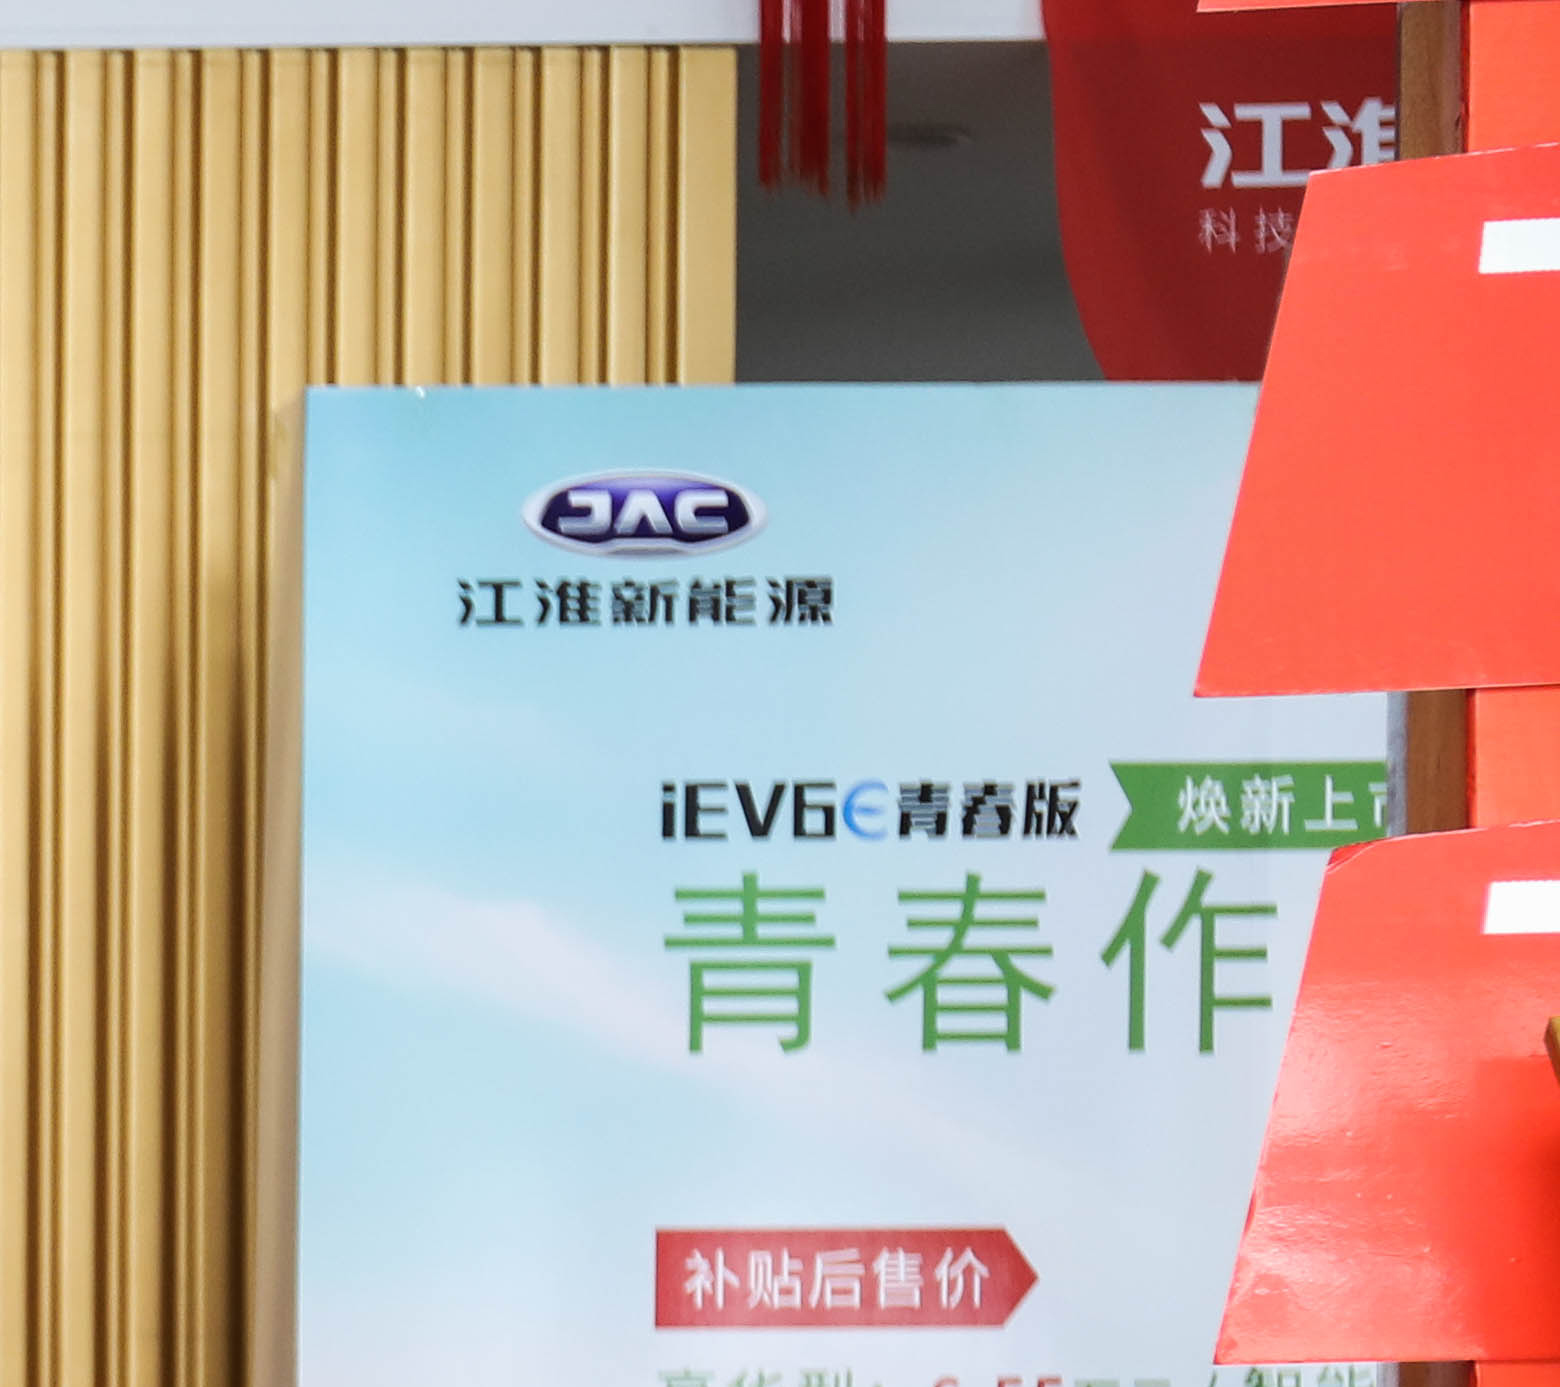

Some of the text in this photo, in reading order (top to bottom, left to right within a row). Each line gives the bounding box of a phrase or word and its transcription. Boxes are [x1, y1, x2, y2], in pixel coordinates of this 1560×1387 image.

[558, 489, 728, 535] JAC
[457, 575, 833, 627] 江淮新能源
[663, 868, 1277, 1053] 青春作
[683, 1247, 989, 1309] 补贴后售价
